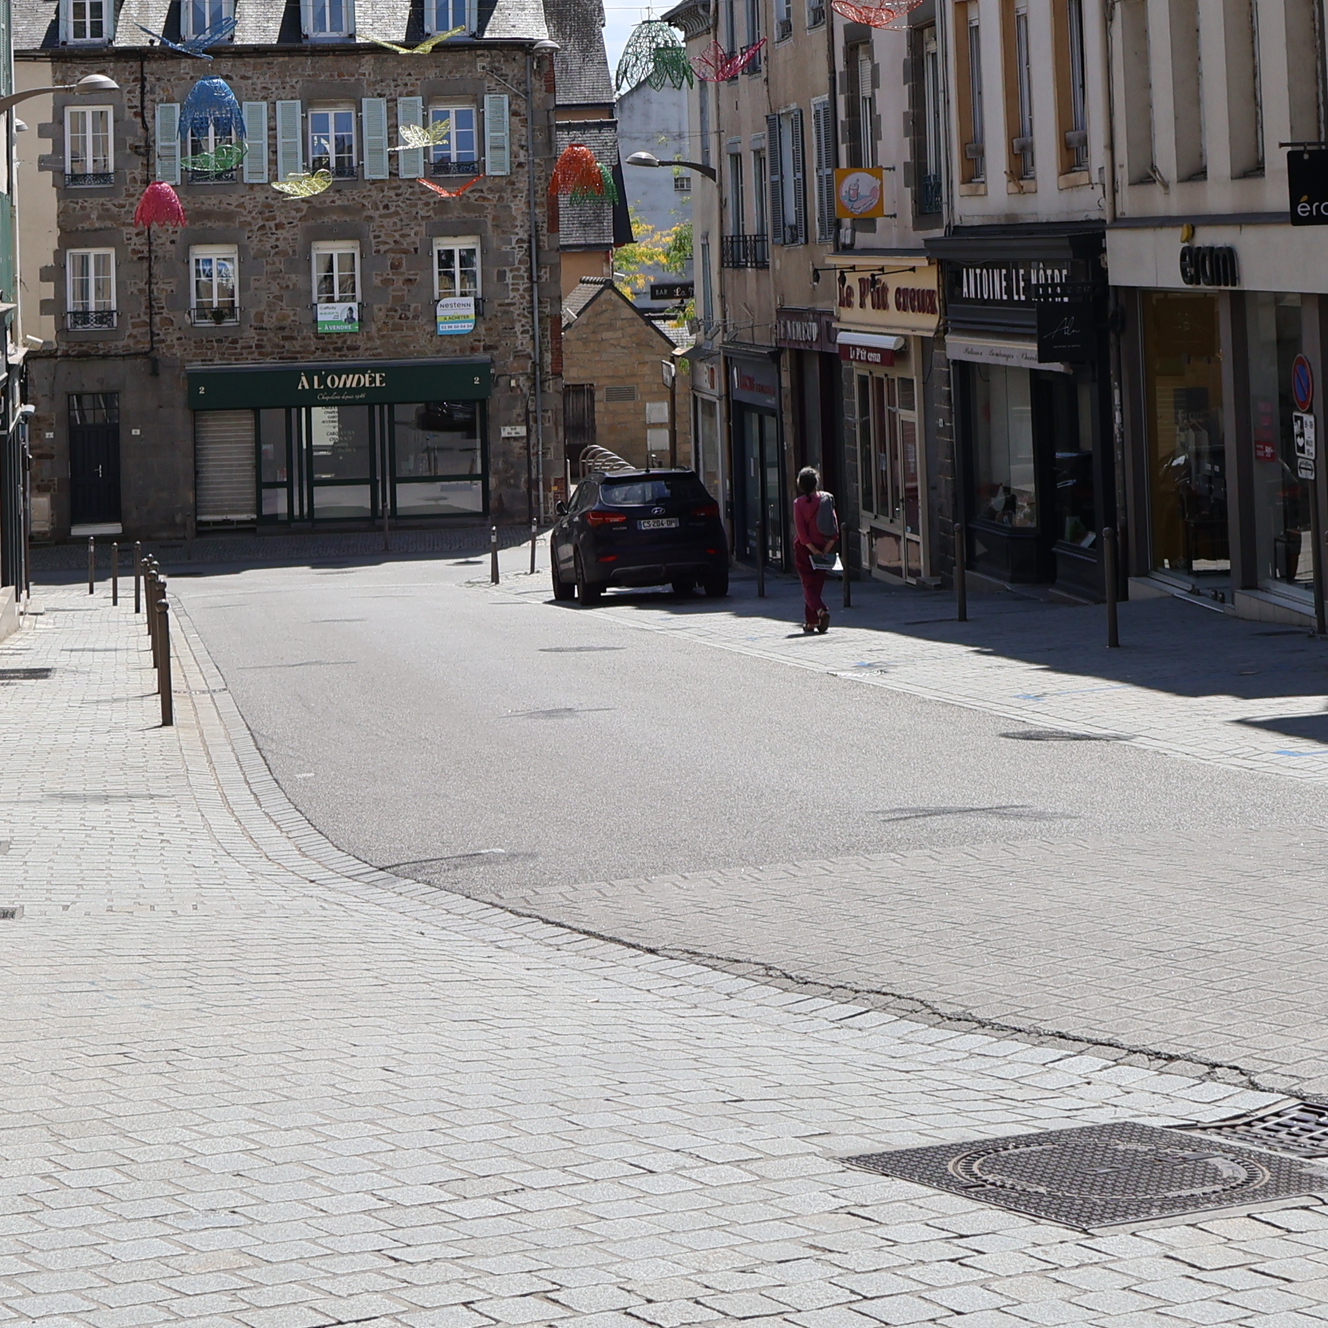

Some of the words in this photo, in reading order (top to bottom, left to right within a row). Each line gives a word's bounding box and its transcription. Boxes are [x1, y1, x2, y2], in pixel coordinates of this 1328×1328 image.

[1180, 224, 1238, 287] éram
[655, 288, 668, 296] BAR
[962, 267, 1008, 301] ANTOINE
[1012, 268, 1026, 301] LE
[838, 277, 855, 308] Le
[894, 287, 938, 315] creux
[297, 371, 310, 390] À
[313, 369, 386, 389] L'ONDÉE
[473, 376, 480, 385] 2
[198, 386, 205, 395] 2
